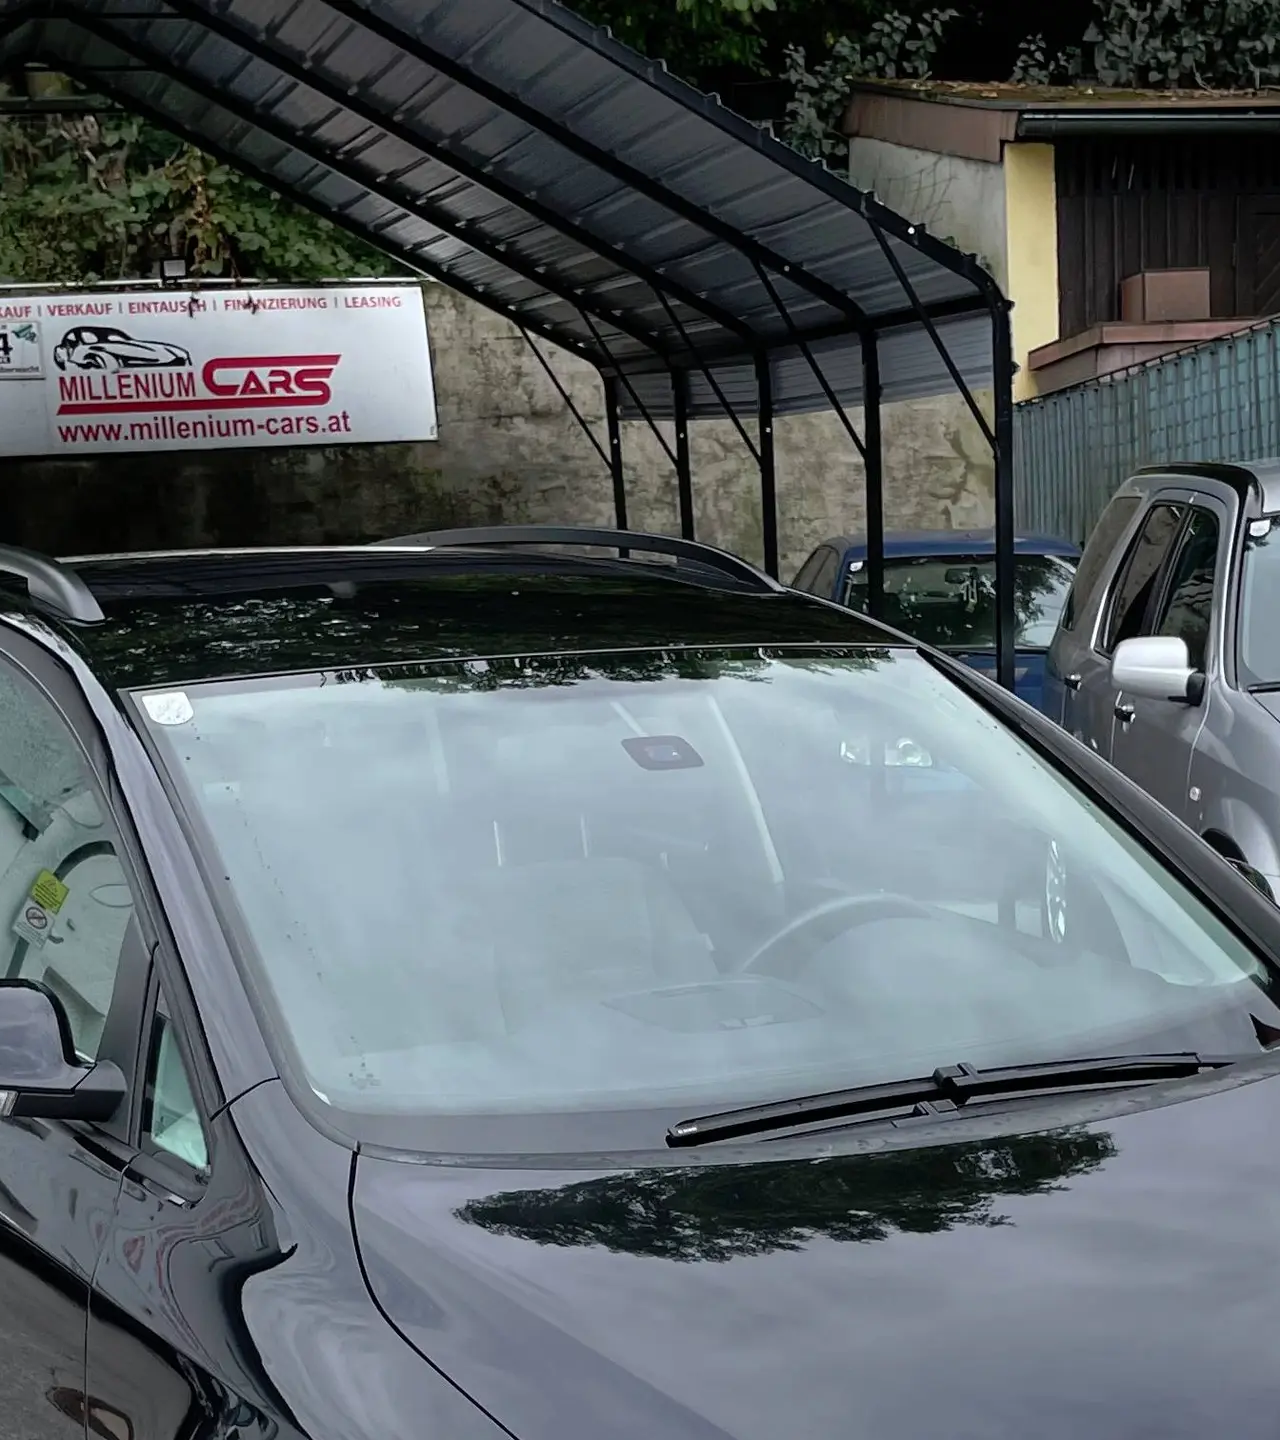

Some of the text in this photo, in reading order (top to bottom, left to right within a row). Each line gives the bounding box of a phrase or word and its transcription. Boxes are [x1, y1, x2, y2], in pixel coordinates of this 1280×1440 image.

[47, 302, 113, 317] VERKAUF
[344, 295, 402, 309] LEASING
[58, 354, 342, 406] MILLENIUM CARS
[58, 410, 352, 443] www.millenium-cars.at
